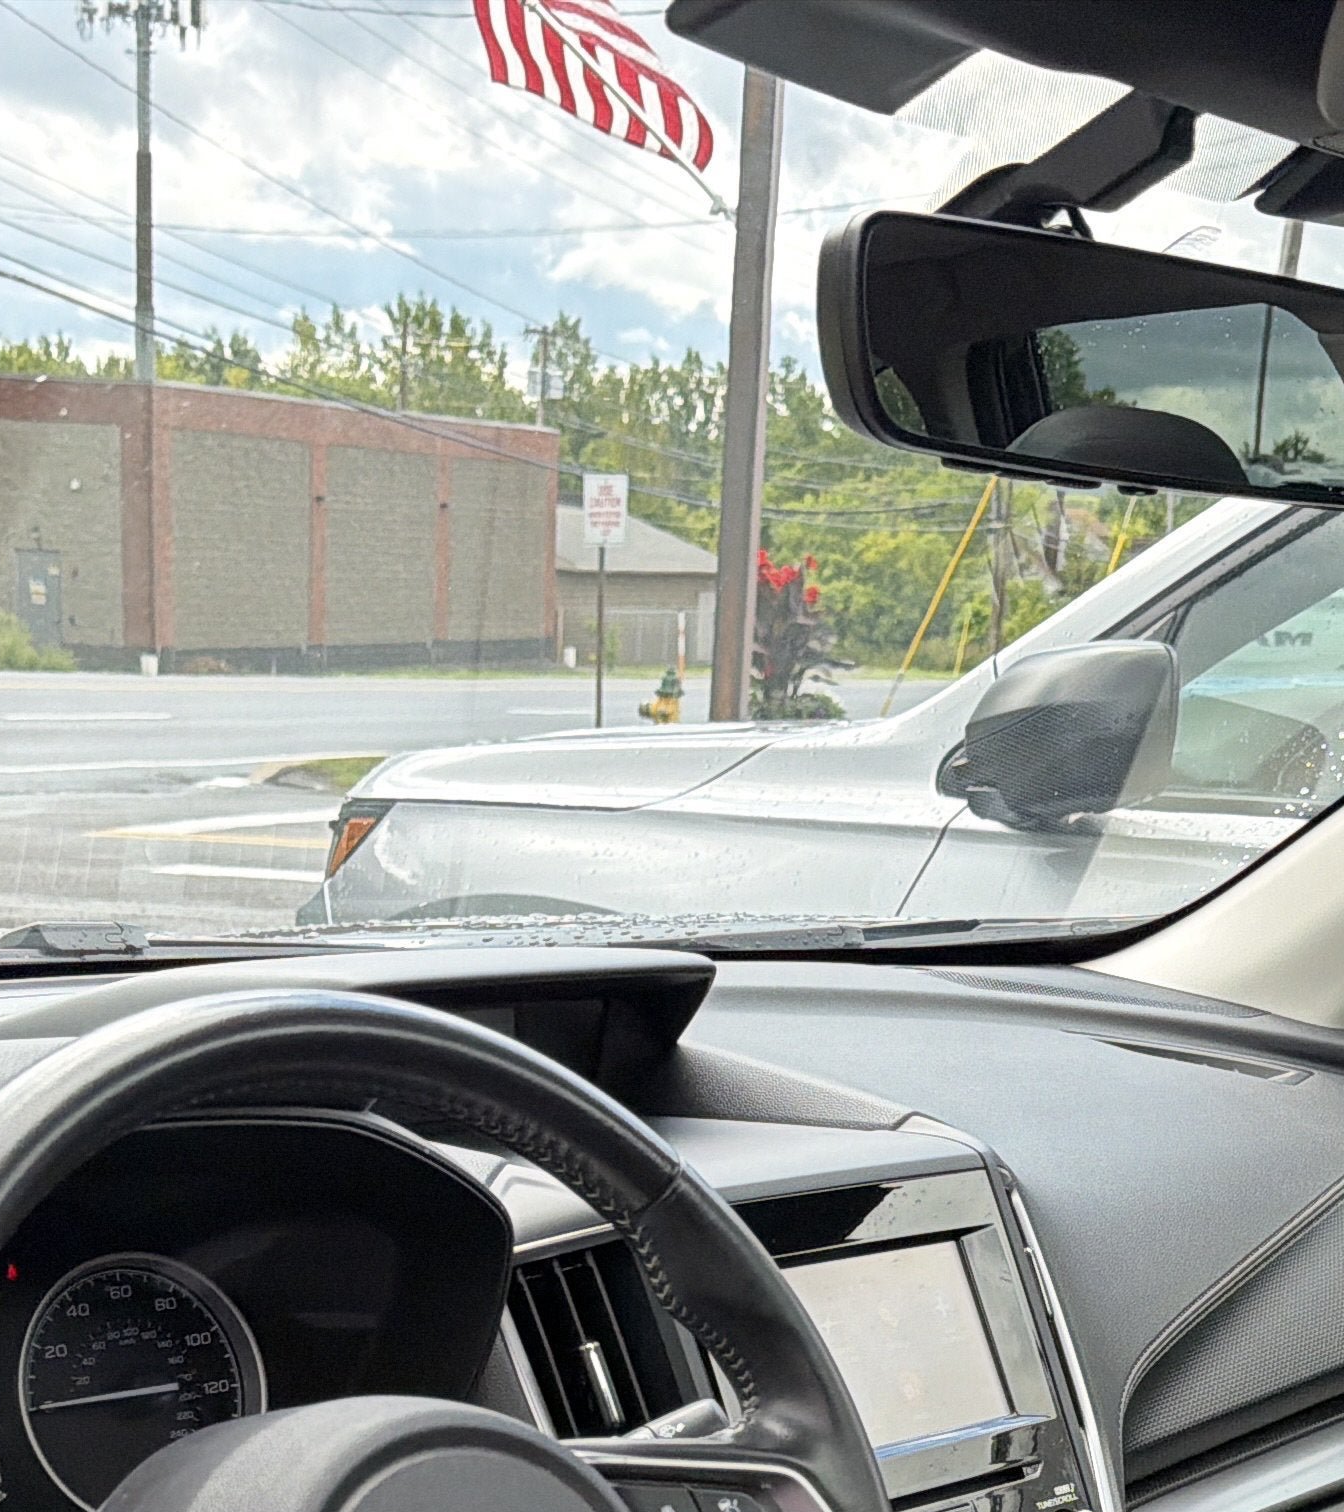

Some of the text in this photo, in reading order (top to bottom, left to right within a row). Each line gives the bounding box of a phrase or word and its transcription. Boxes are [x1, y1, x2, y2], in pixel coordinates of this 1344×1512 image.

[109, 1284, 132, 1300] 60
[66, 1303, 90, 1318] 40
[155, 1297, 177, 1312] 80
[184, 1331, 212, 1347] 100
[44, 1343, 68, 1359] 20
[203, 1379, 230, 1395] 120
